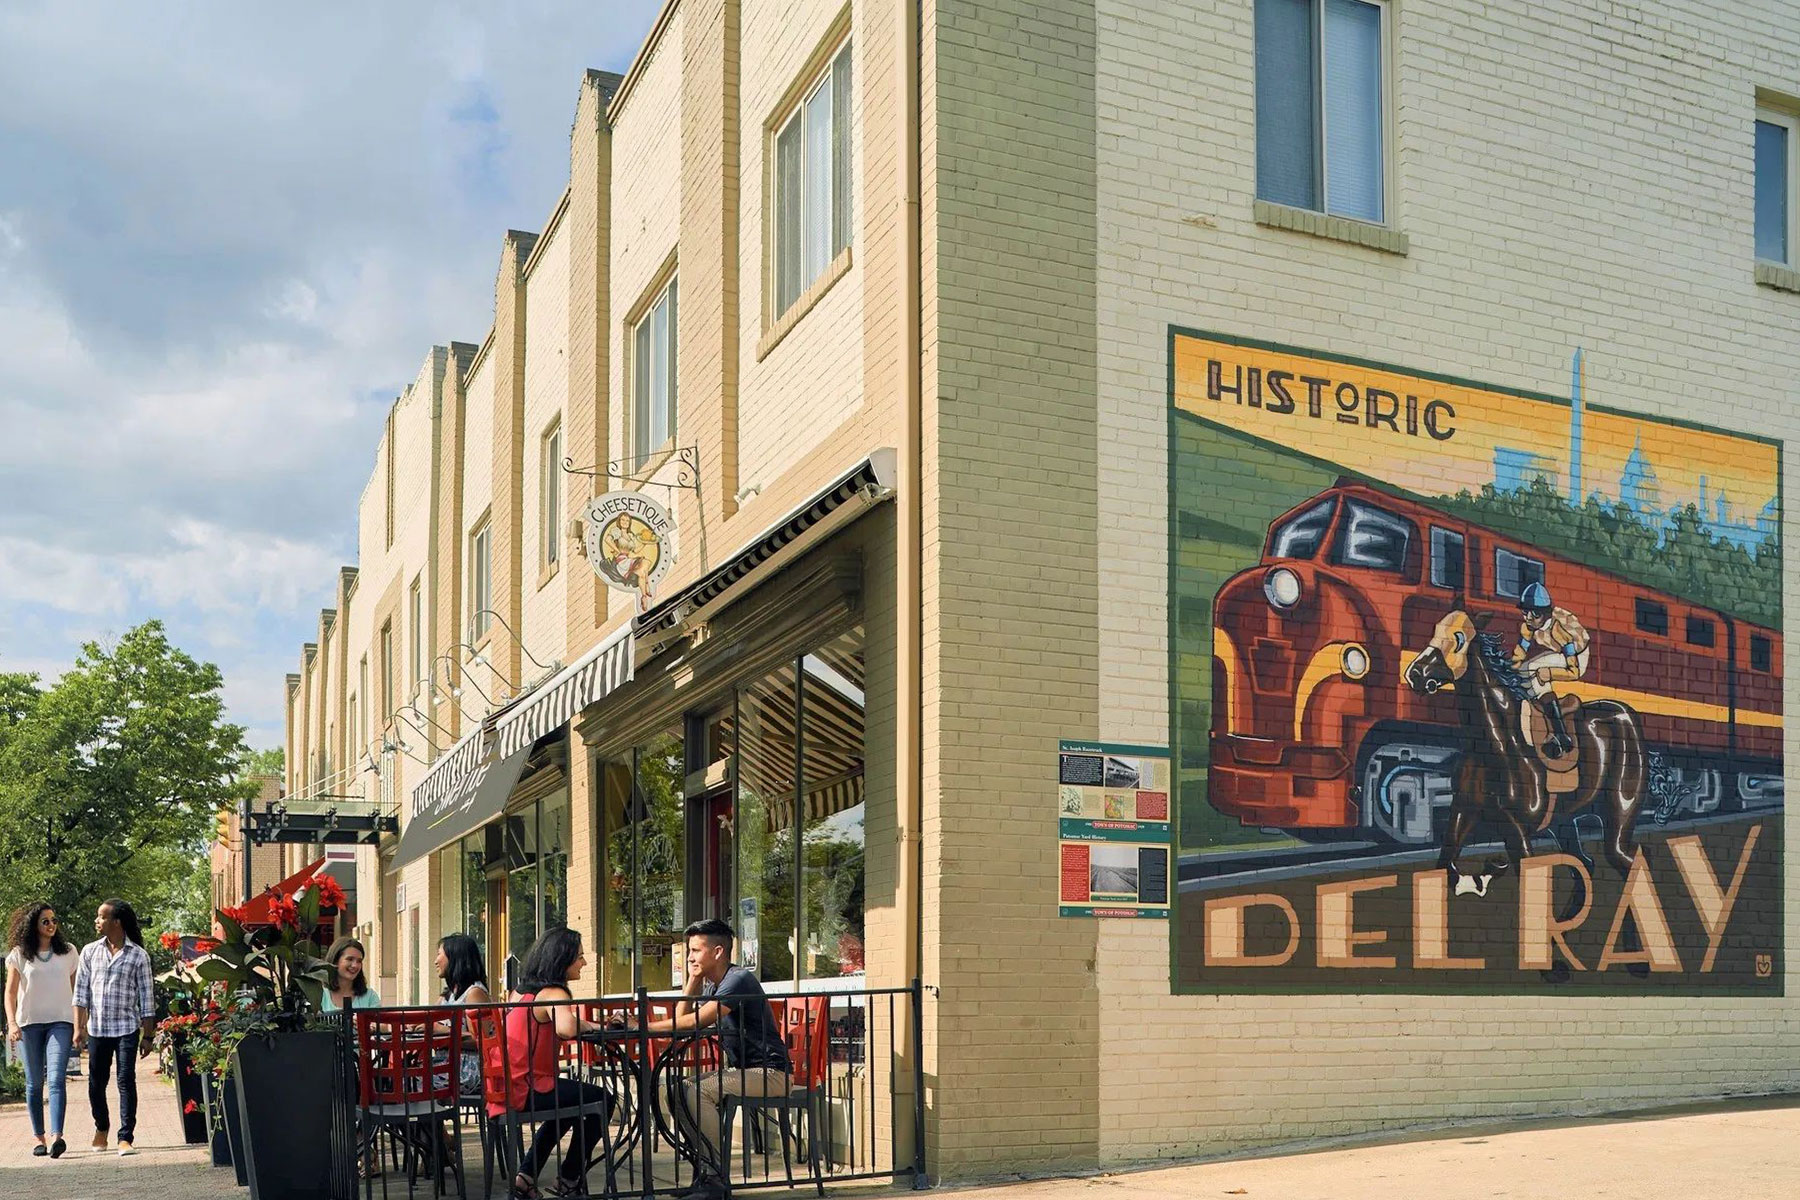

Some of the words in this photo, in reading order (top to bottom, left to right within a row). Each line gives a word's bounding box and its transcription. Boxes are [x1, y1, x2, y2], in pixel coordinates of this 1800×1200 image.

[1207, 359, 1456, 441] HISTORIC
[591, 497, 669, 532] CHEESETIQUE
[1203, 868, 1486, 970] DEL
[1518, 824, 1762, 973] RAY
